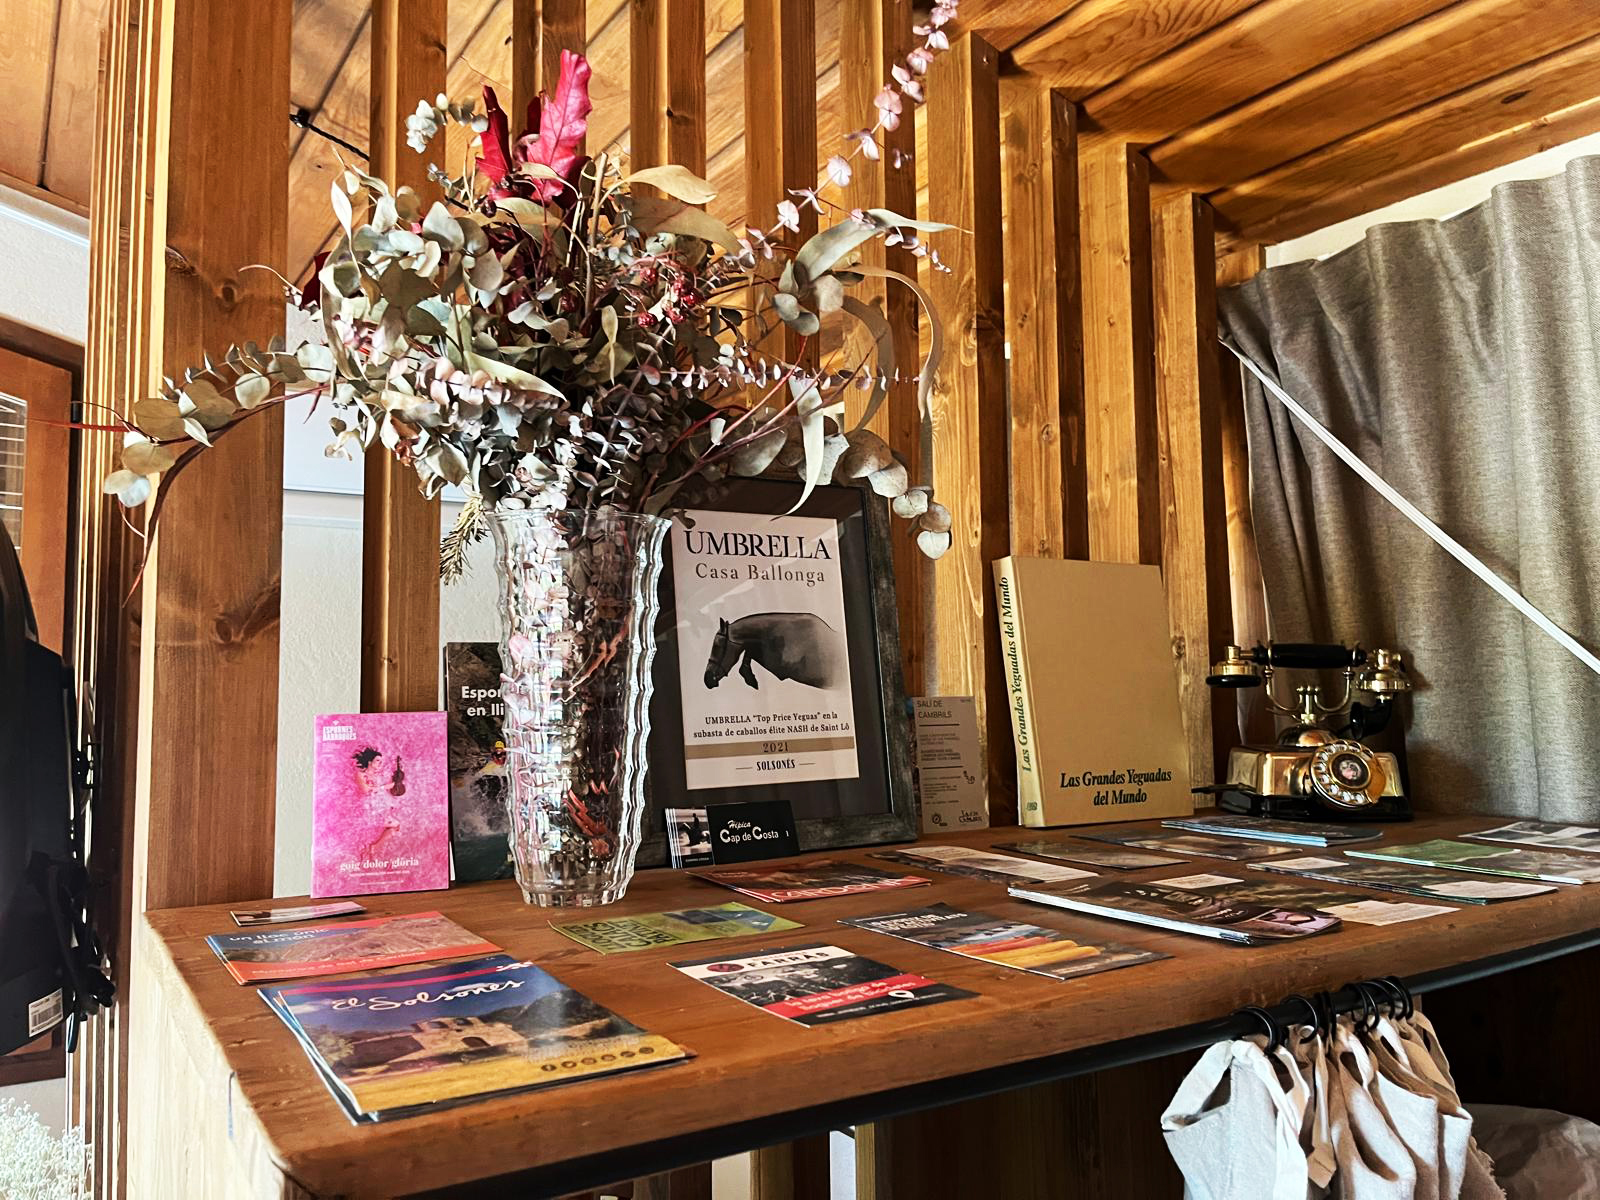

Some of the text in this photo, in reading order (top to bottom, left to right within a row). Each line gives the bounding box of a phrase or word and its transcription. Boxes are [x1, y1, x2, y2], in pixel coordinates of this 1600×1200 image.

[684, 530, 832, 560] UMBRELLA
[695, 562, 825, 587] Casa Ballonga
[999, 577, 1032, 772] Las Grandes Yeguadas del Mundo
[466, 706, 487, 717] en
[705, 716, 751, 725] UMBRELLA
[773, 713, 792, 722] Price
[831, 711, 838, 719] la
[693, 729, 723, 738] subasta
[725, 728, 734, 736] de
[736, 726, 767, 736] caballos
[769, 725, 786, 734] élite
[787, 724, 809, 733] NASH
[810, 724, 819, 732] de
[820, 723, 839, 732] Saint
[763, 742, 789, 753] 2021
[1060, 767, 1172, 788] Las Grandes Yeguadas
[1093, 788, 1147, 806] del Mundo
[720, 828, 740, 844] Cap
[742, 832, 752, 841] de
[752, 826, 779, 840] Costa
[363, 859, 389, 869] dolor
[332, 997, 367, 1010] El
